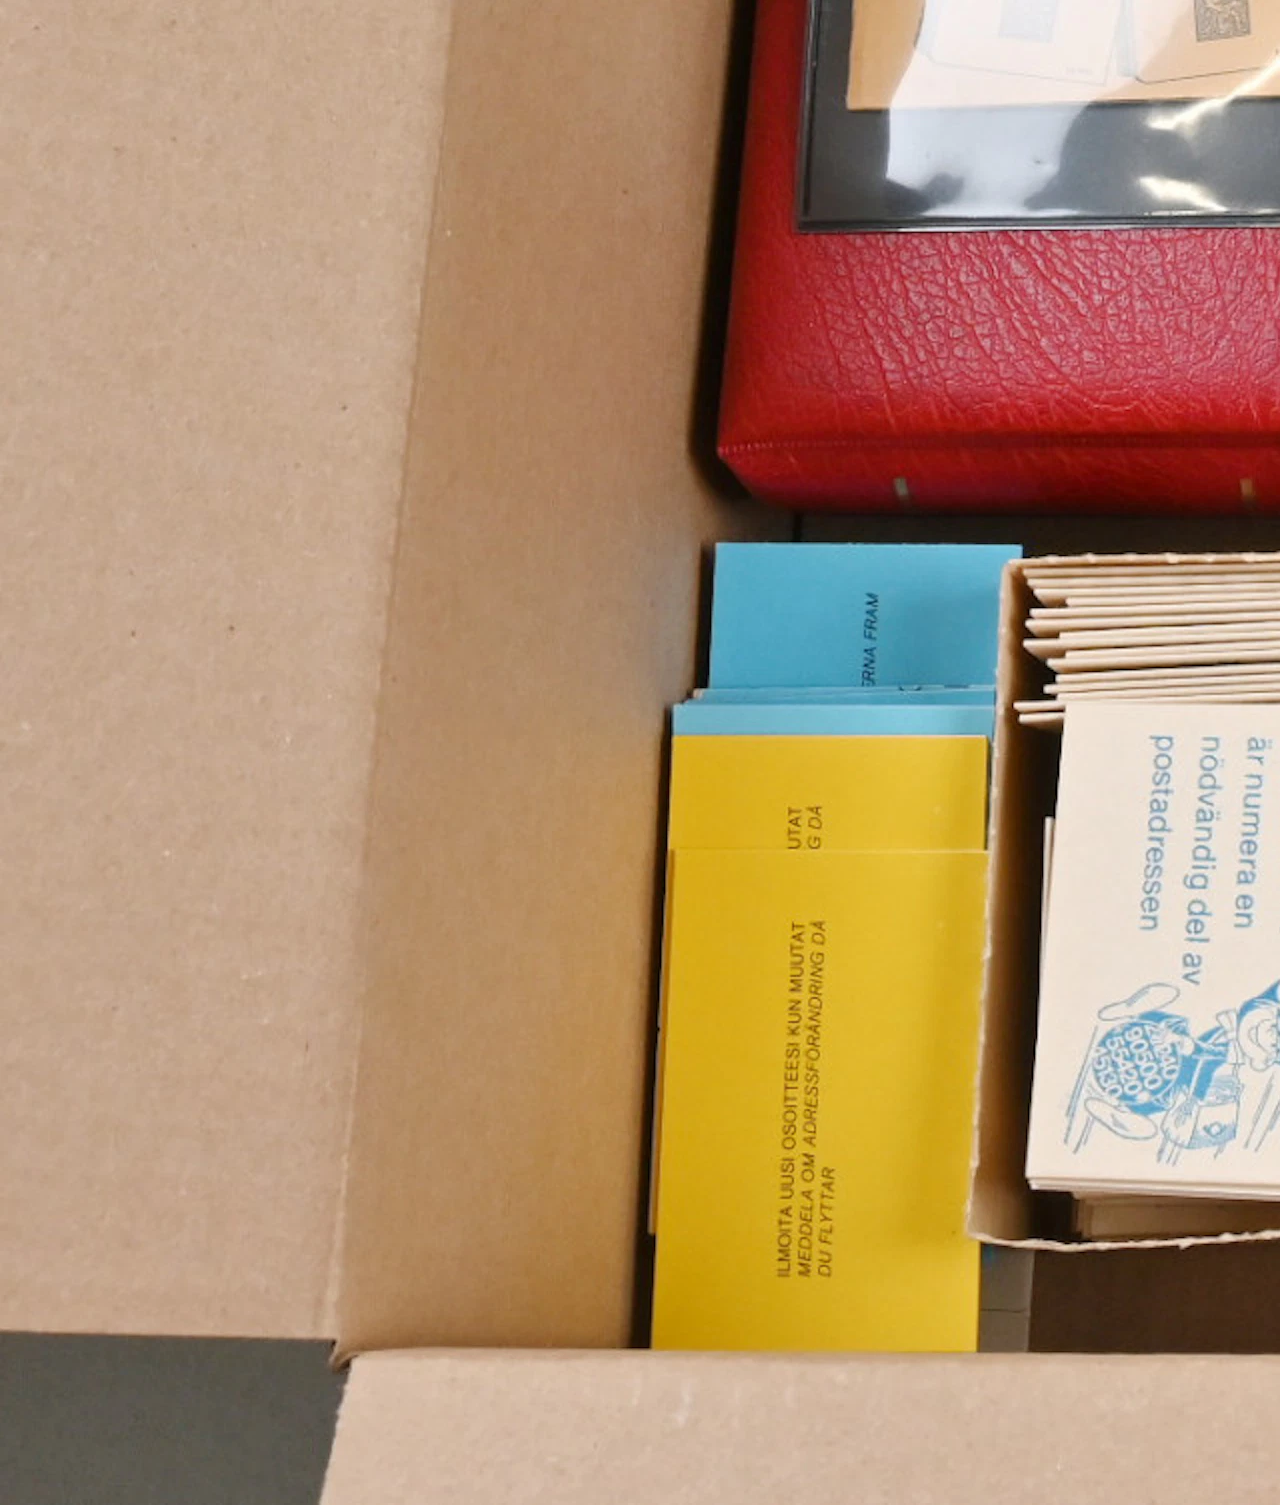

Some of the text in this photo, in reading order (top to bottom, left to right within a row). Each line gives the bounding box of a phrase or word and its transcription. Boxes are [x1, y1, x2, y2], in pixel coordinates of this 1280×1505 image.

[863, 592, 880, 641] FRAM
[1140, 734, 1176, 931] postadressen
[1182, 736, 1223, 987] nödvändig del av
[1234, 736, 1274, 929] är numera en
[777, 921, 806, 1278] ILMOITA UUSI OSOITTEESI KUN MUUTAT
[801, 1152, 815, 1183] OM
[797, 1188, 814, 1277] MEDDELA
[817, 1165, 836, 1278] DU FLYTTAR
